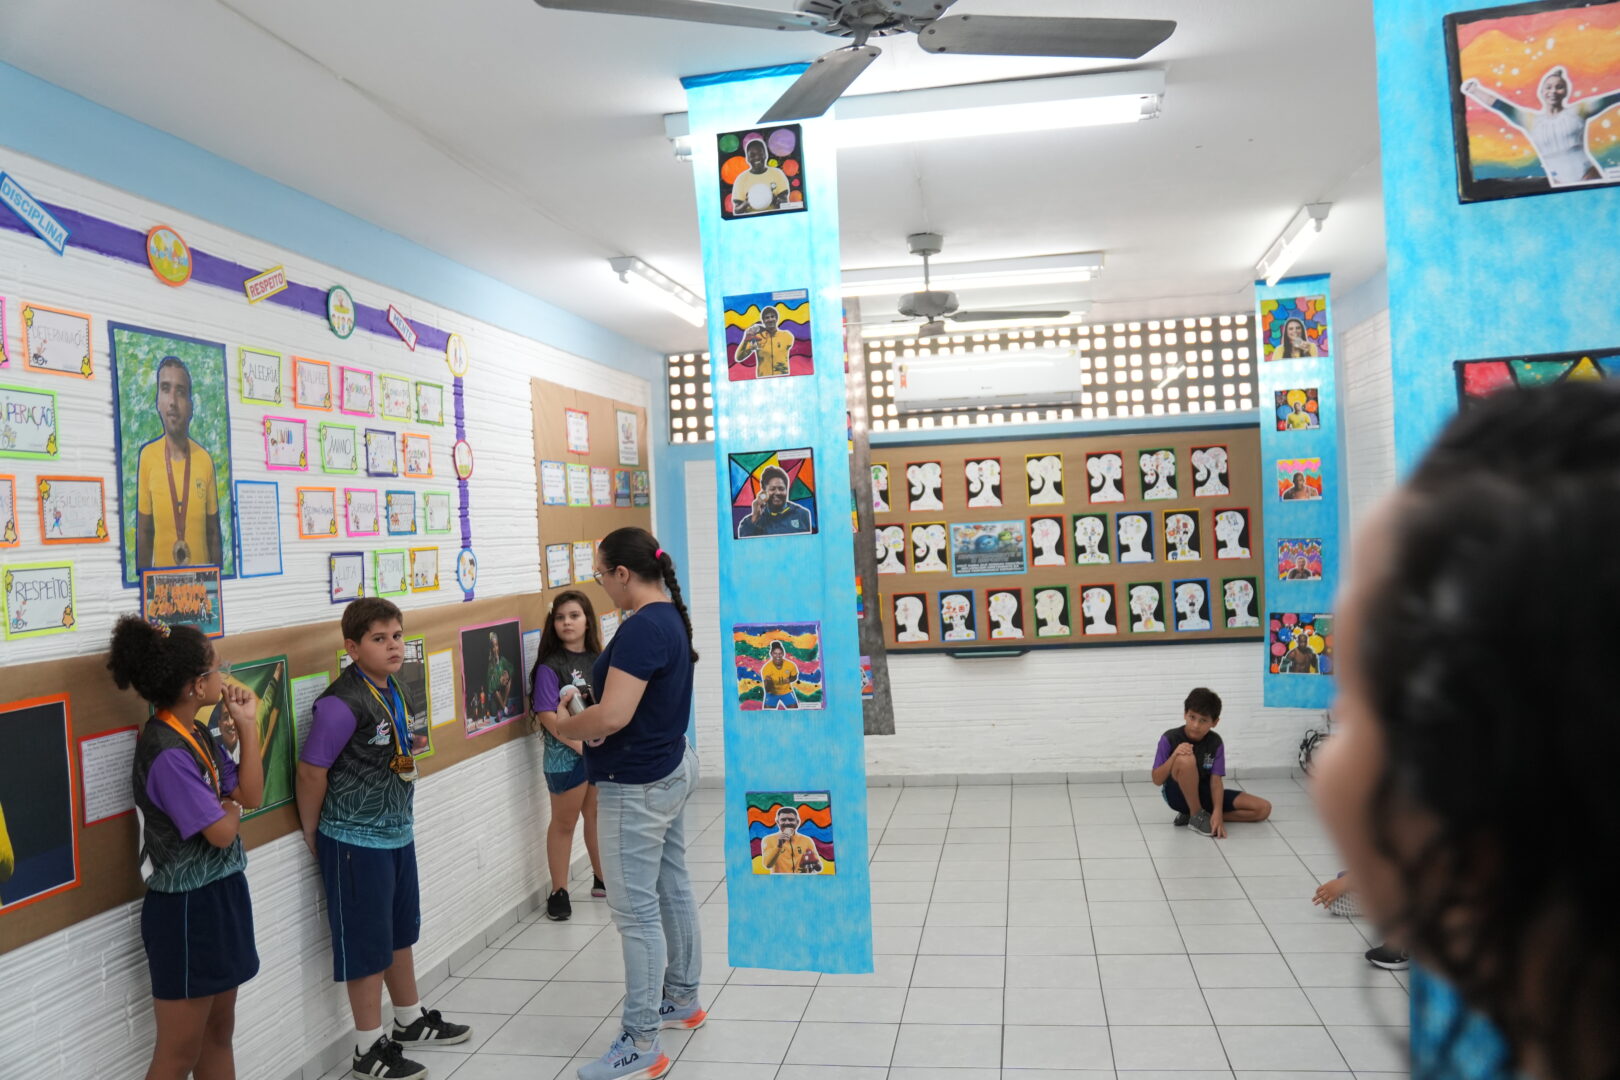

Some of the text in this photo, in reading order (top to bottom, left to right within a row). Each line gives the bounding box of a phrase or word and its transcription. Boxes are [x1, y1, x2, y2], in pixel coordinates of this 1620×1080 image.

[2, 182, 64, 246] DISCIPLINA
[249, 272, 284, 297] RESPEITO
[0, 402, 53, 430] UPERAÇÃO
[15, 577, 69, 601] RESPEITO
[659, 1005, 676, 1015] ILA
[613, 1052, 639, 1068] FILA
